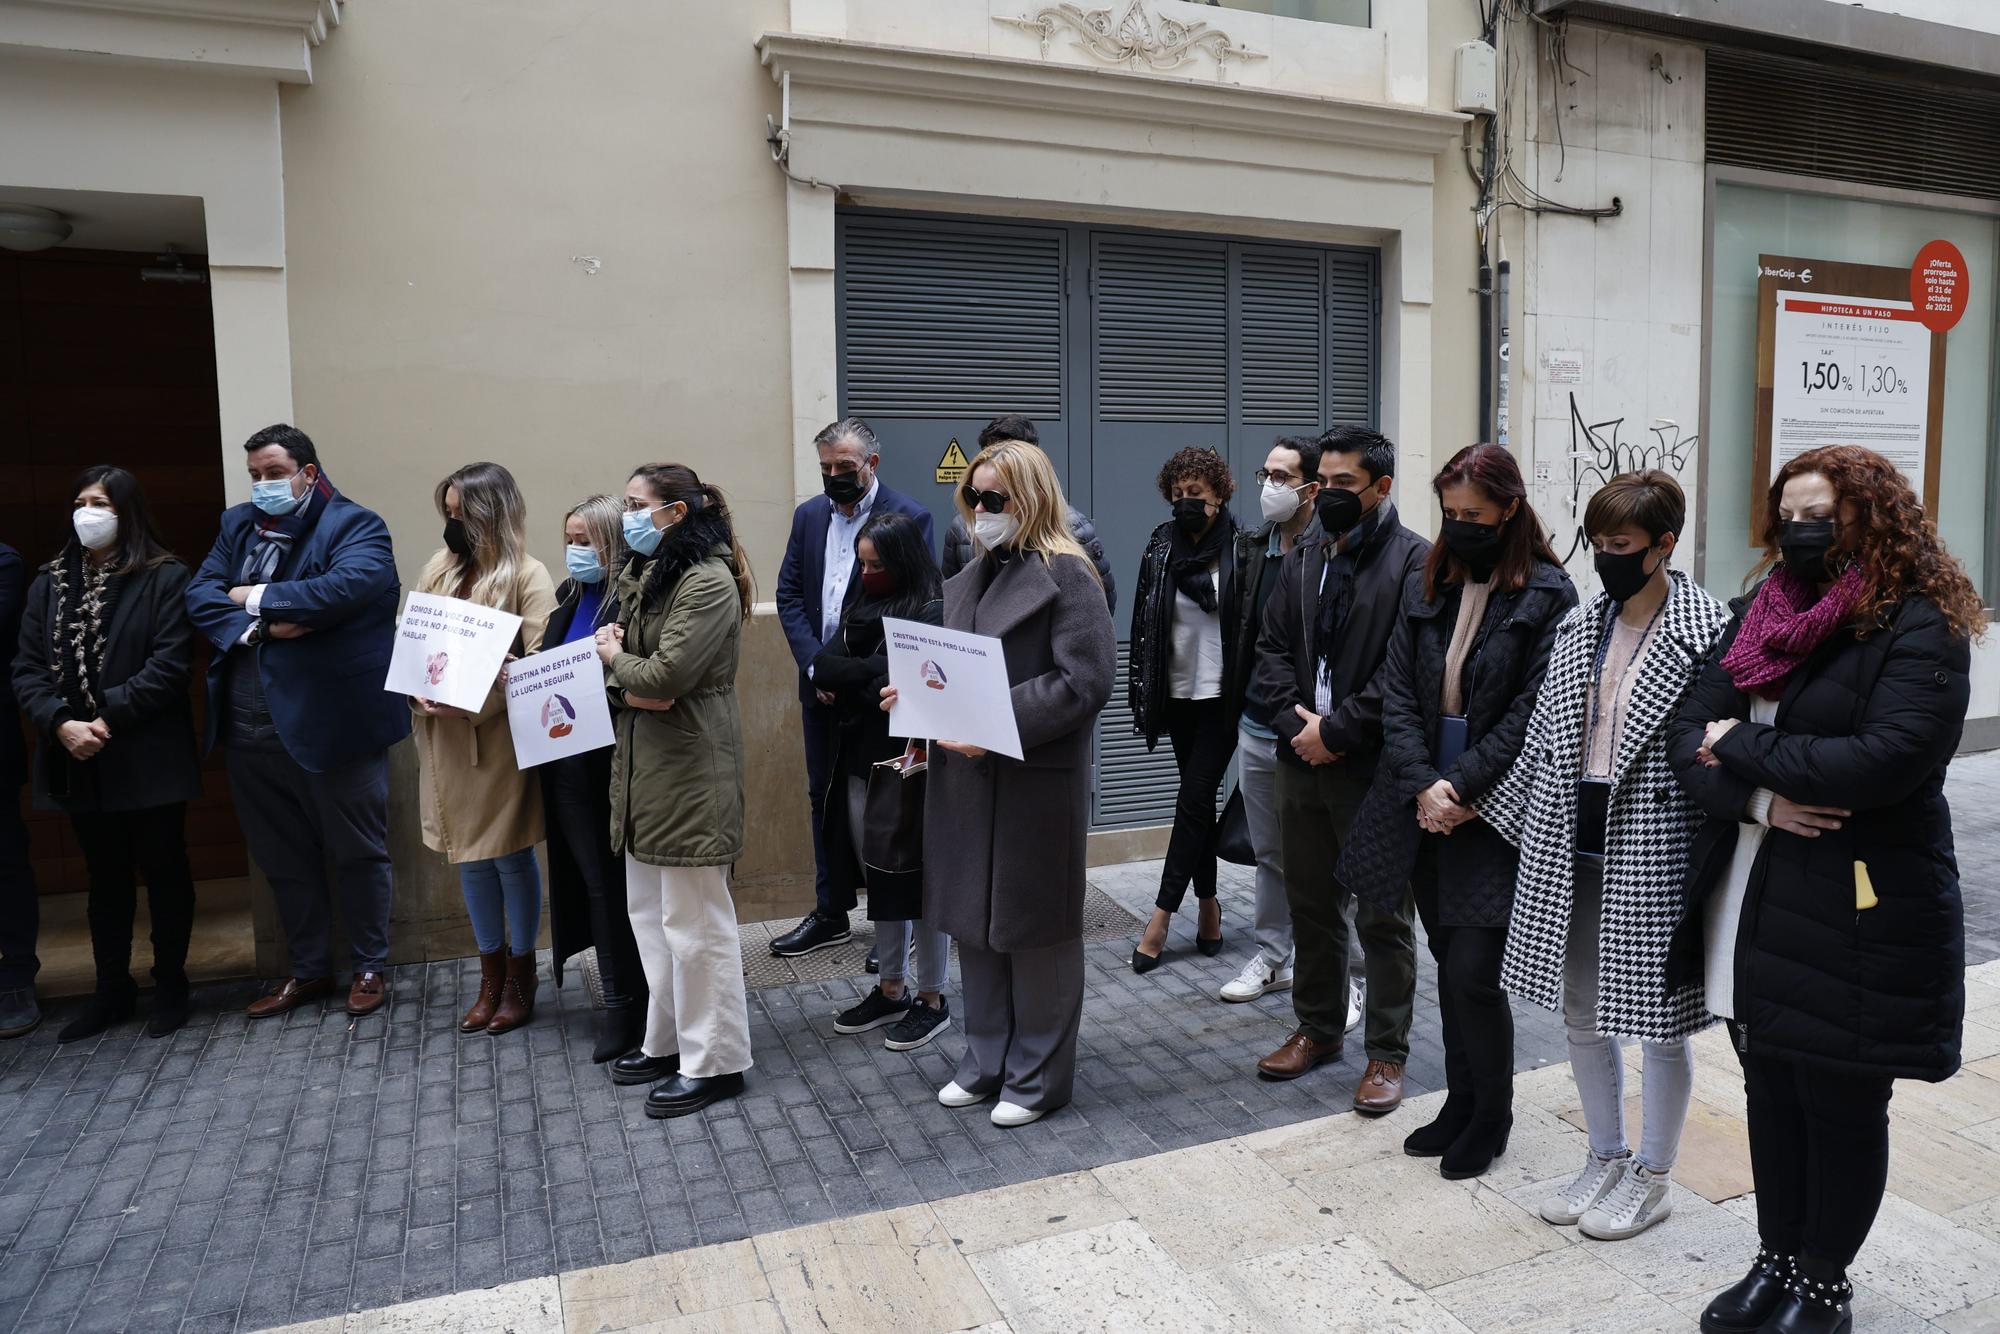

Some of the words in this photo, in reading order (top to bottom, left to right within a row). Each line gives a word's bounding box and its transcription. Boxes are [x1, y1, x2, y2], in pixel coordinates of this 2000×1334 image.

[1929, 259, 1952, 268] ¡Oferta
[1923, 268, 1957, 278] prorrogada
[1938, 277, 1955, 286] hasta
[1928, 285, 1934, 293] el
[1927, 294, 1951, 303] octubre
[1821, 305, 1854, 315] HIPOTECA
[1874, 310, 1891, 318] PASO
[1934, 304, 1953, 312] 2021!
[1822, 322, 1862, 332] INTERÉS
[410, 604, 433, 615] SOMOS
[433, 608, 443, 617] LA
[463, 616, 475, 625] DE
[477, 619, 495, 630] LAS
[406, 618, 419, 626] QUE
[430, 621, 440, 630] NO
[442, 624, 477, 638] PUEDEN
[402, 630, 427, 640] HABLAR
[893, 632, 918, 642] CRISTINA
[943, 642, 958, 650] PERO
[967, 648, 986, 657] LUCHA
[509, 669, 539, 684] CRISTINA
[541, 665, 551, 674] NO
[572, 651, 592, 664] PERO
[511, 690, 519, 698] LA
[520, 682, 542, 695] LUCHA
